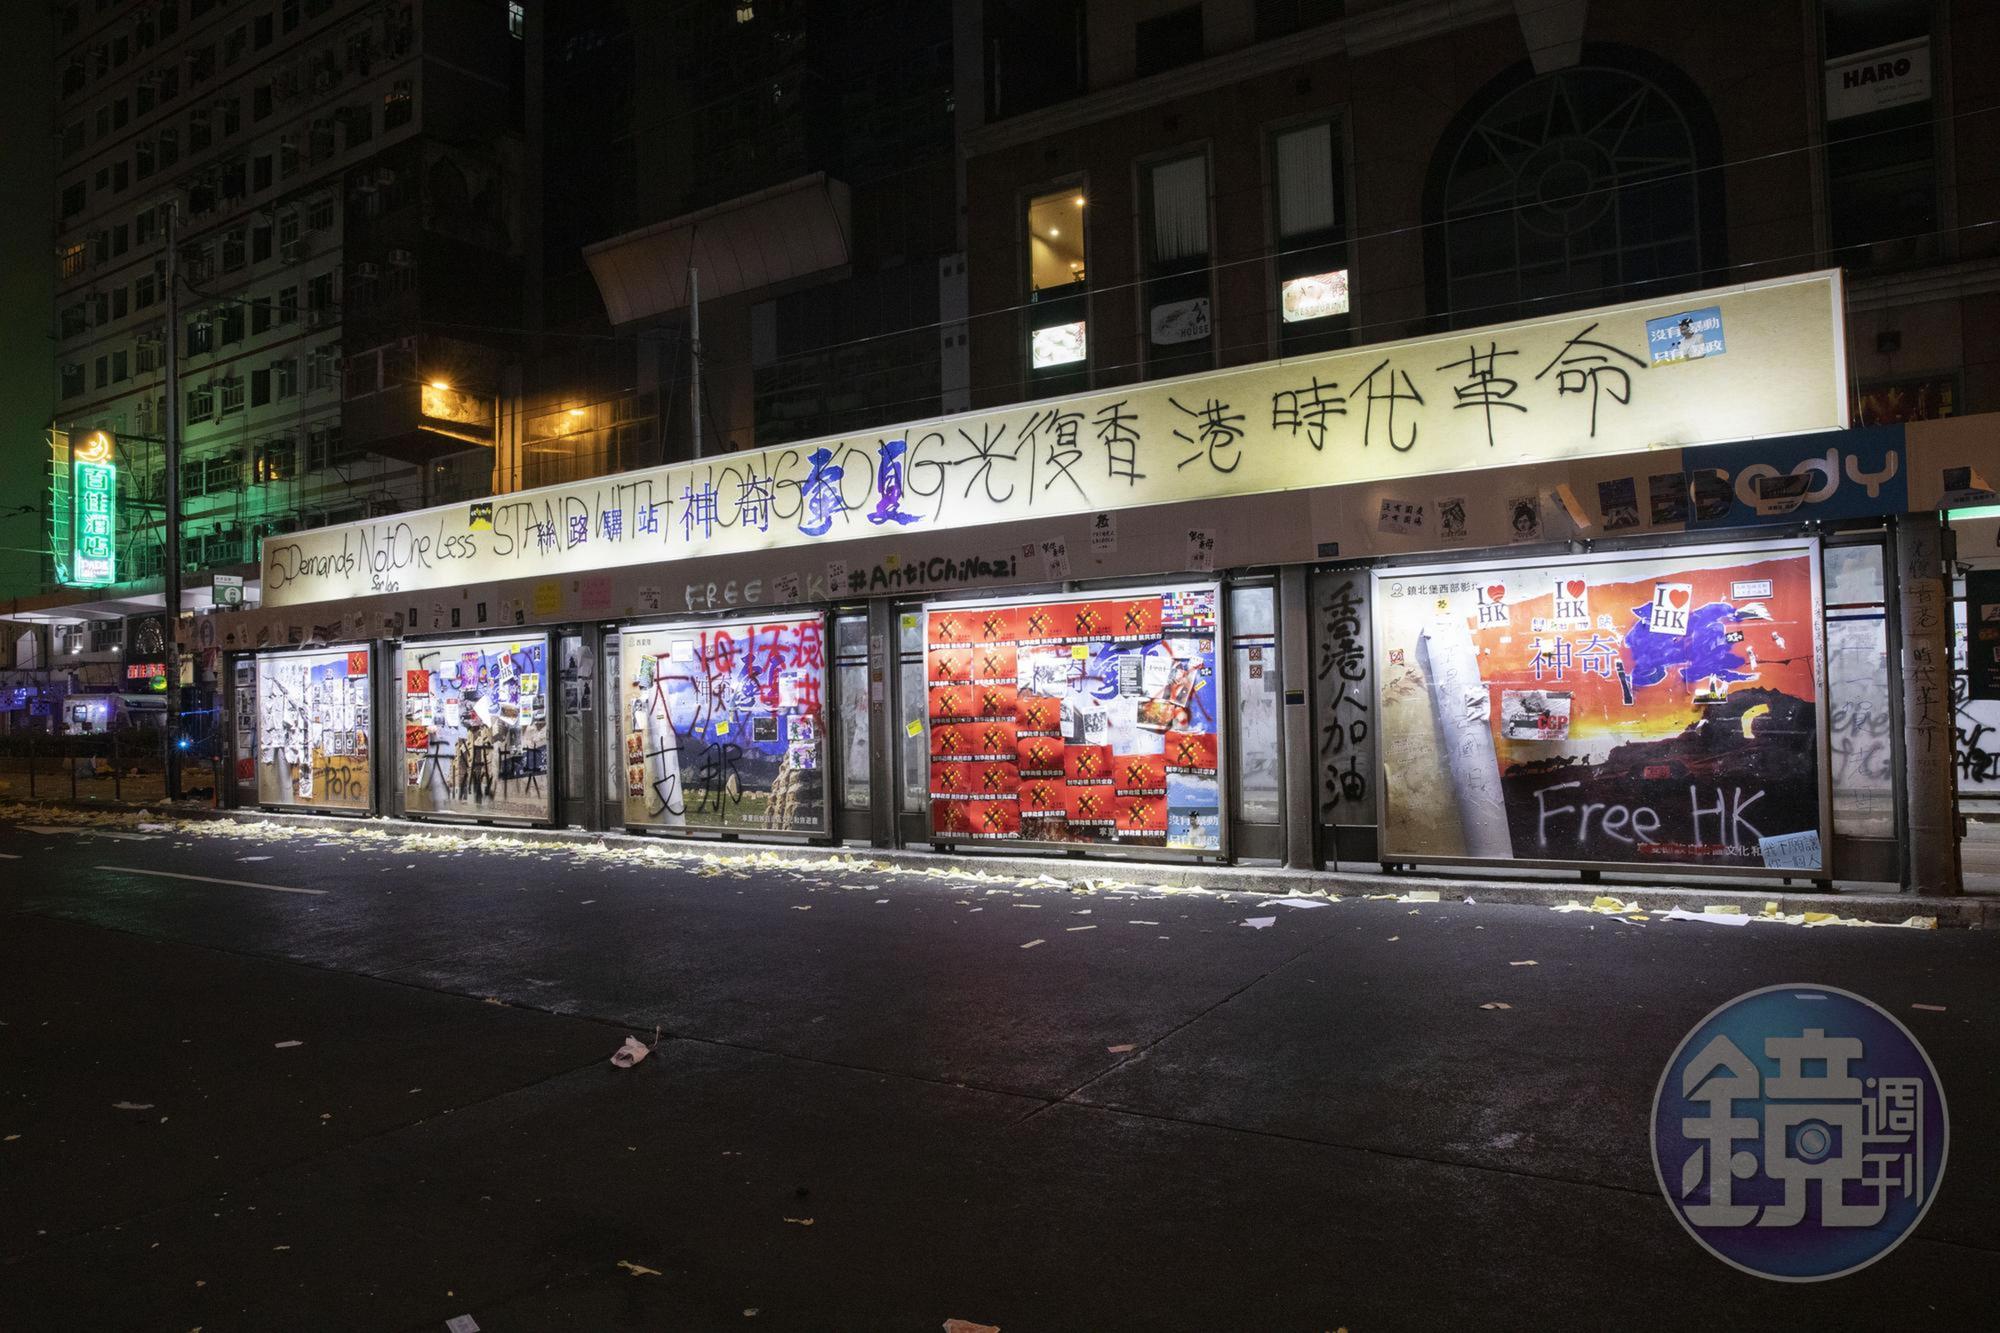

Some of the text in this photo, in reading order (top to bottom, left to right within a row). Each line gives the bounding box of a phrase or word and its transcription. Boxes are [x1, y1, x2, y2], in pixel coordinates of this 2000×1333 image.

[1843, 58, 1911, 89] HARO
[1181, 324, 1209, 337] HOUSE
[493, 496, 589, 559] STAND
[595, 471, 674, 545] WITH
[815, 429, 956, 524] KONG
[680, 475, 776, 542] 神奇
[436, 516, 477, 560] Less
[847, 554, 1017, 592] #AntiChiNazi
[685, 578, 763, 611] FREE
[1475, 586, 1485, 606] I
[1554, 580, 1564, 600] I
[1656, 588, 1666, 608] I
[1478, 603, 1509, 624] HK
[1556, 600, 1586, 619] HK
[1653, 609, 1686, 630] HK
[1528, 635, 1619, 680] 神奇
[1318, 580, 1368, 812] 香港人加油
[1533, 780, 1766, 849] Free HK
